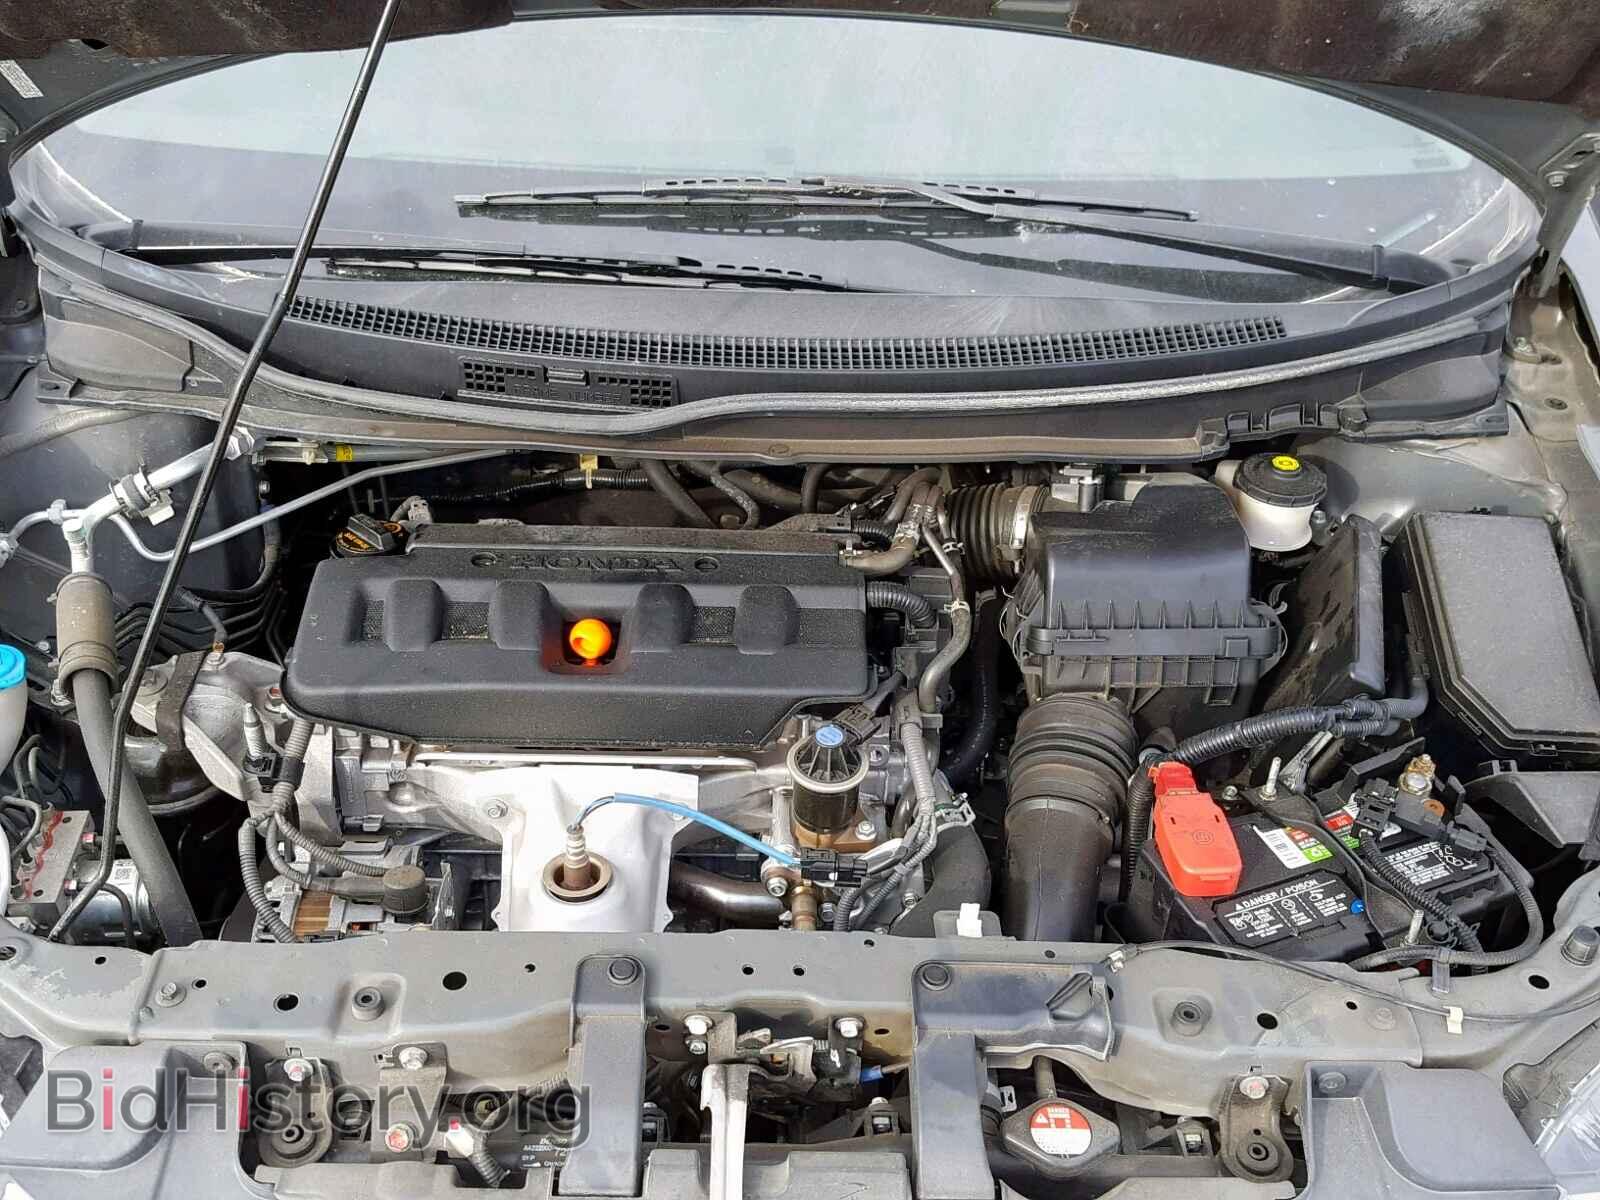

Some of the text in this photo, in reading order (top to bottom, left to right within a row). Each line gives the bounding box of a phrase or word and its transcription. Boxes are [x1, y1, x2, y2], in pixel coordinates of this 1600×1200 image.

[510, 556, 684, 572] HONDA
[1242, 892, 1279, 908] DANGER
[1285, 879, 1318, 895] POISON
